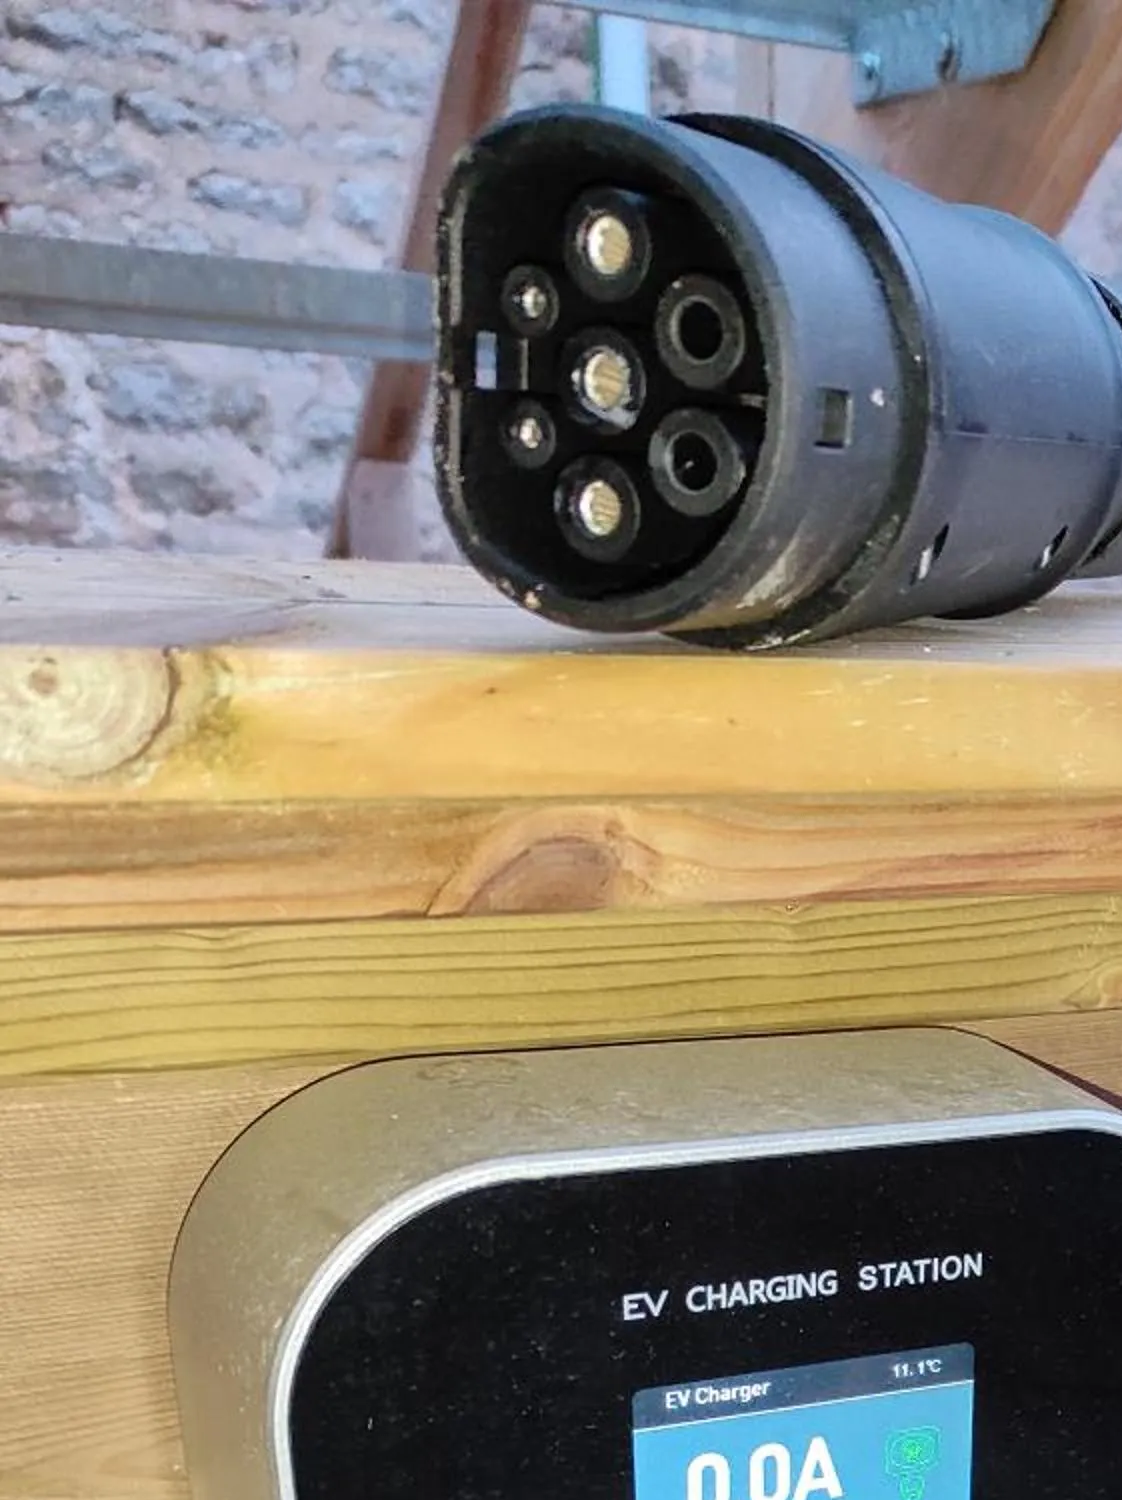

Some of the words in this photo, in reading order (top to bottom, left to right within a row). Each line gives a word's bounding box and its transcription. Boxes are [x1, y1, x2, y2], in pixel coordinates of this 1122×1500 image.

[622, 1290, 669, 1321] EV
[686, 1270, 838, 1314] CHARGING
[858, 1253, 983, 1291] STATION
[665, 1391, 690, 1409] EV
[696, 1381, 771, 1405] Charger
